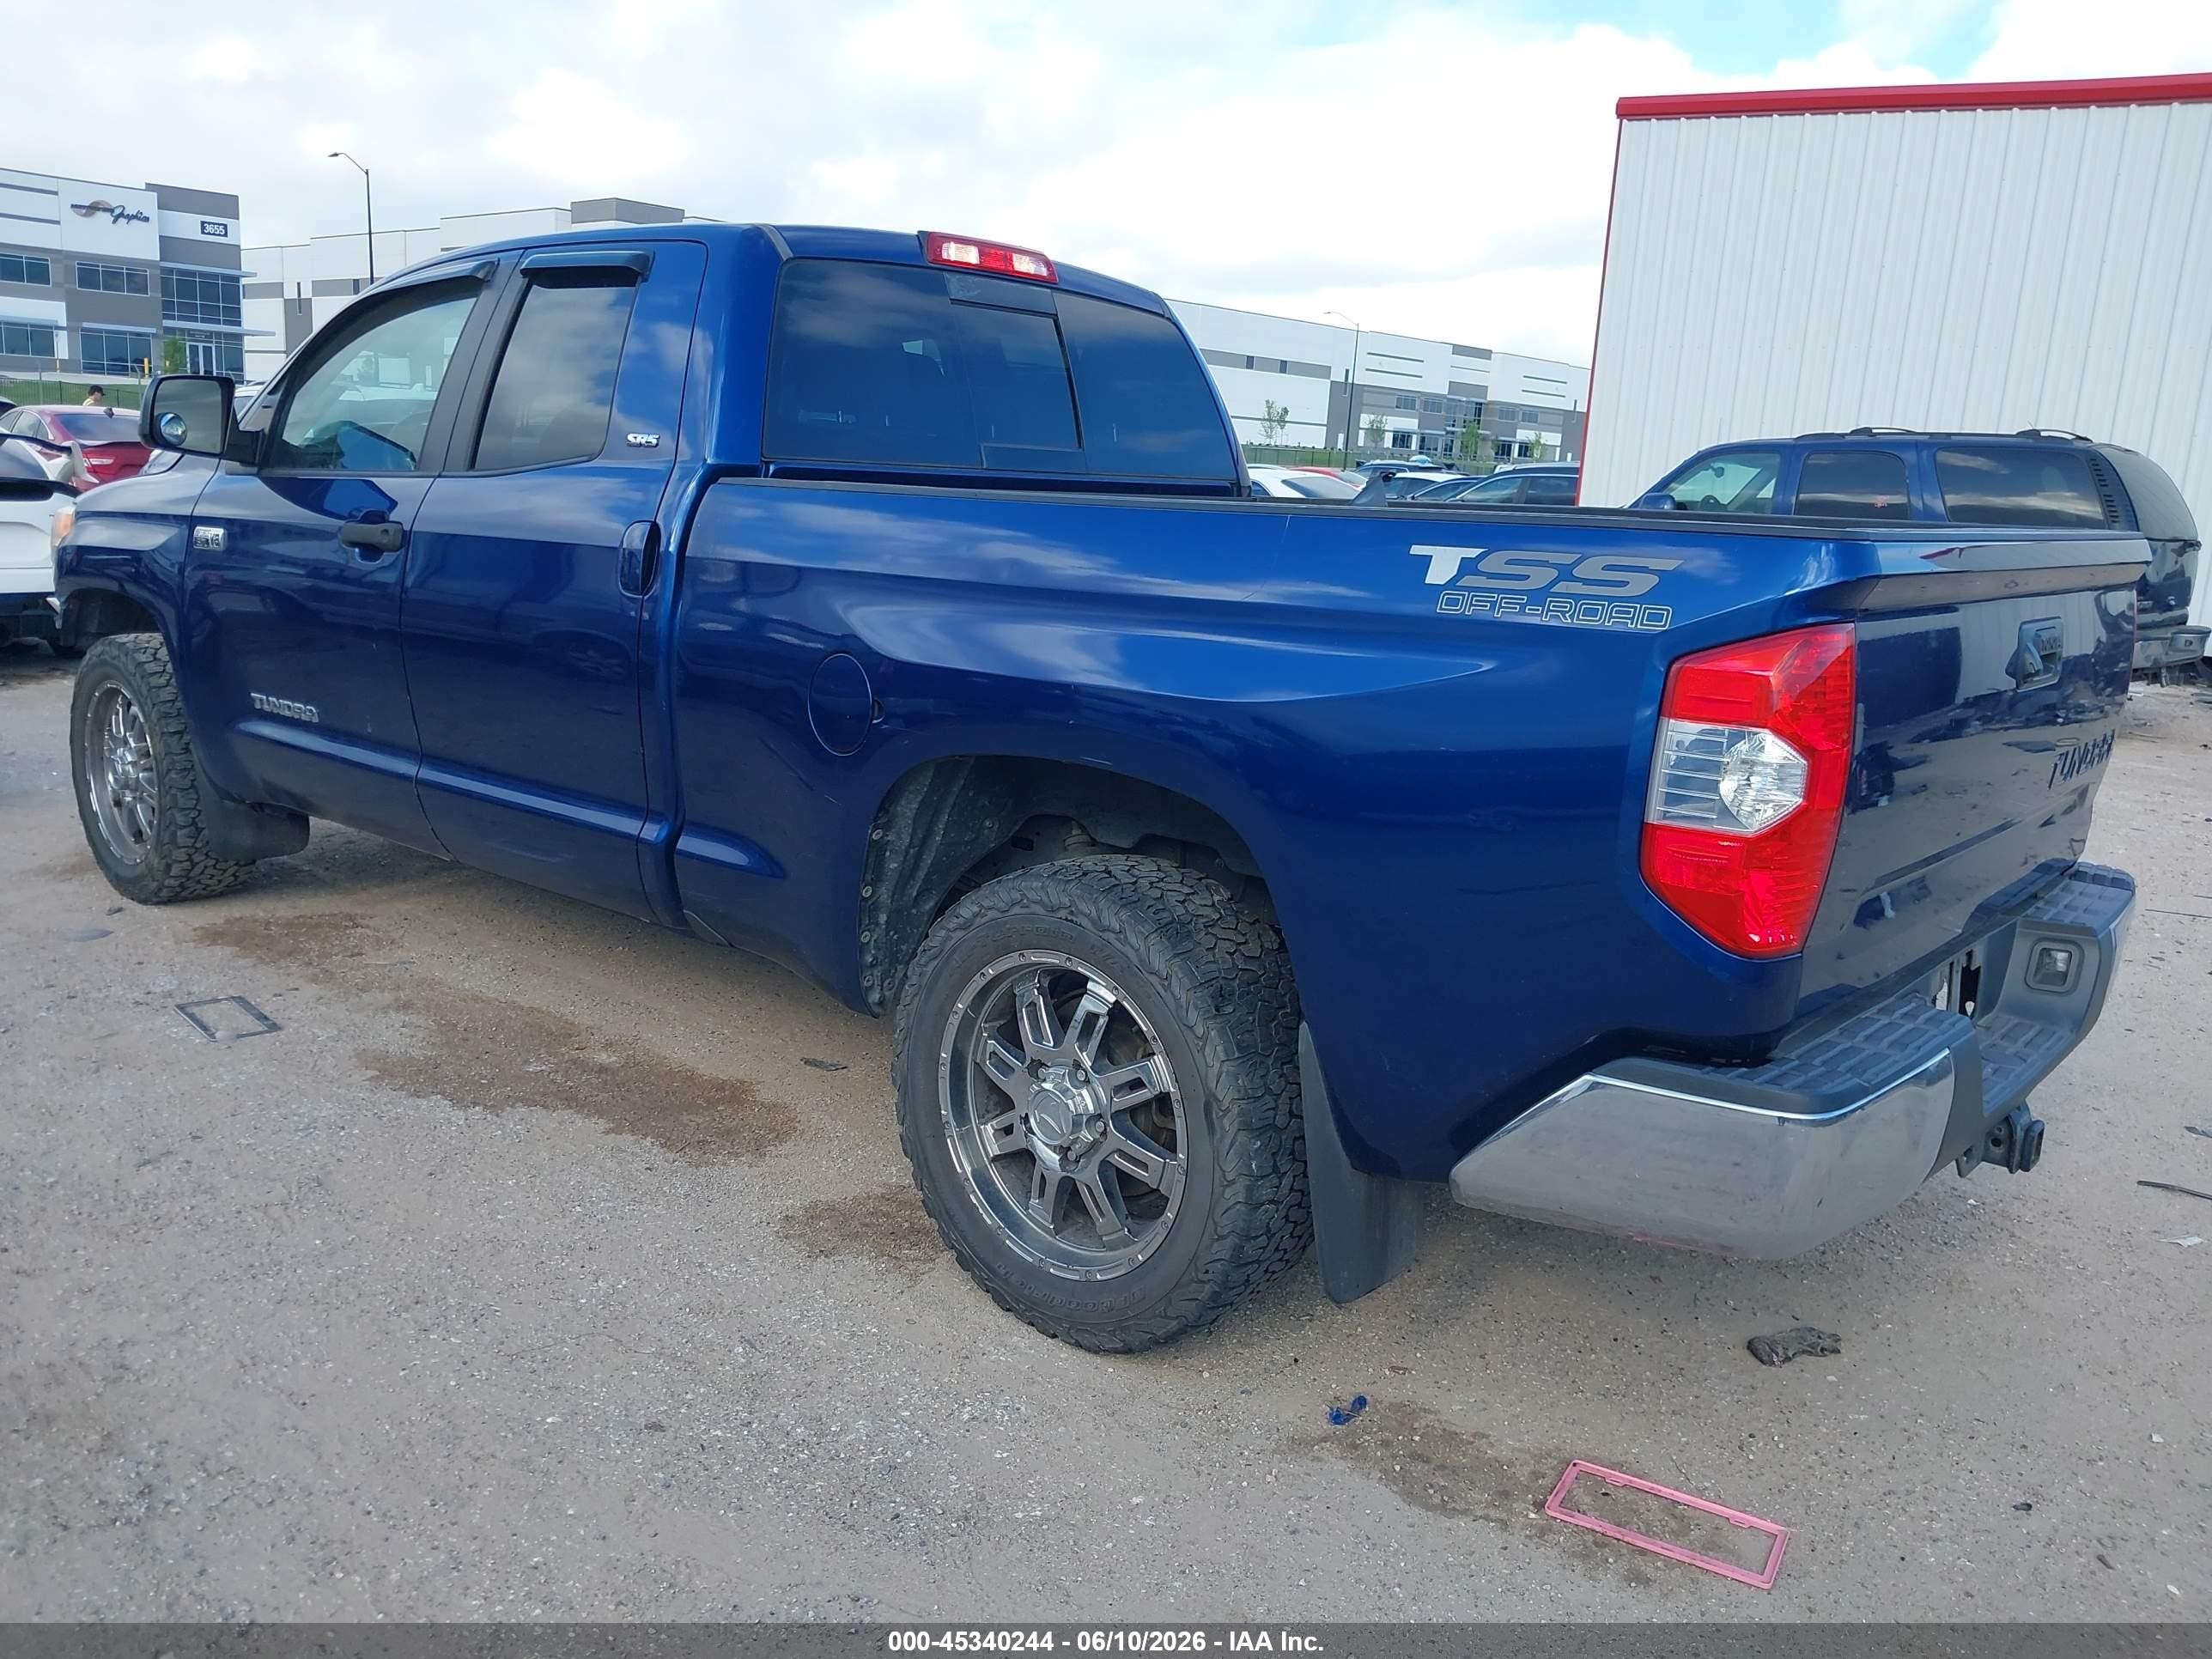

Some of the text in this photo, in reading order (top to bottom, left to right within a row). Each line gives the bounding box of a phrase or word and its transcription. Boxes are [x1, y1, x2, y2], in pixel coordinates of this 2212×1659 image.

[204, 223, 225, 235] 3655
[627, 433, 659, 447] SR5
[1409, 544, 1684, 598] TSS
[1437, 591, 1673, 630] OFF-ROAD
[250, 692, 319, 722] TUNDRA
